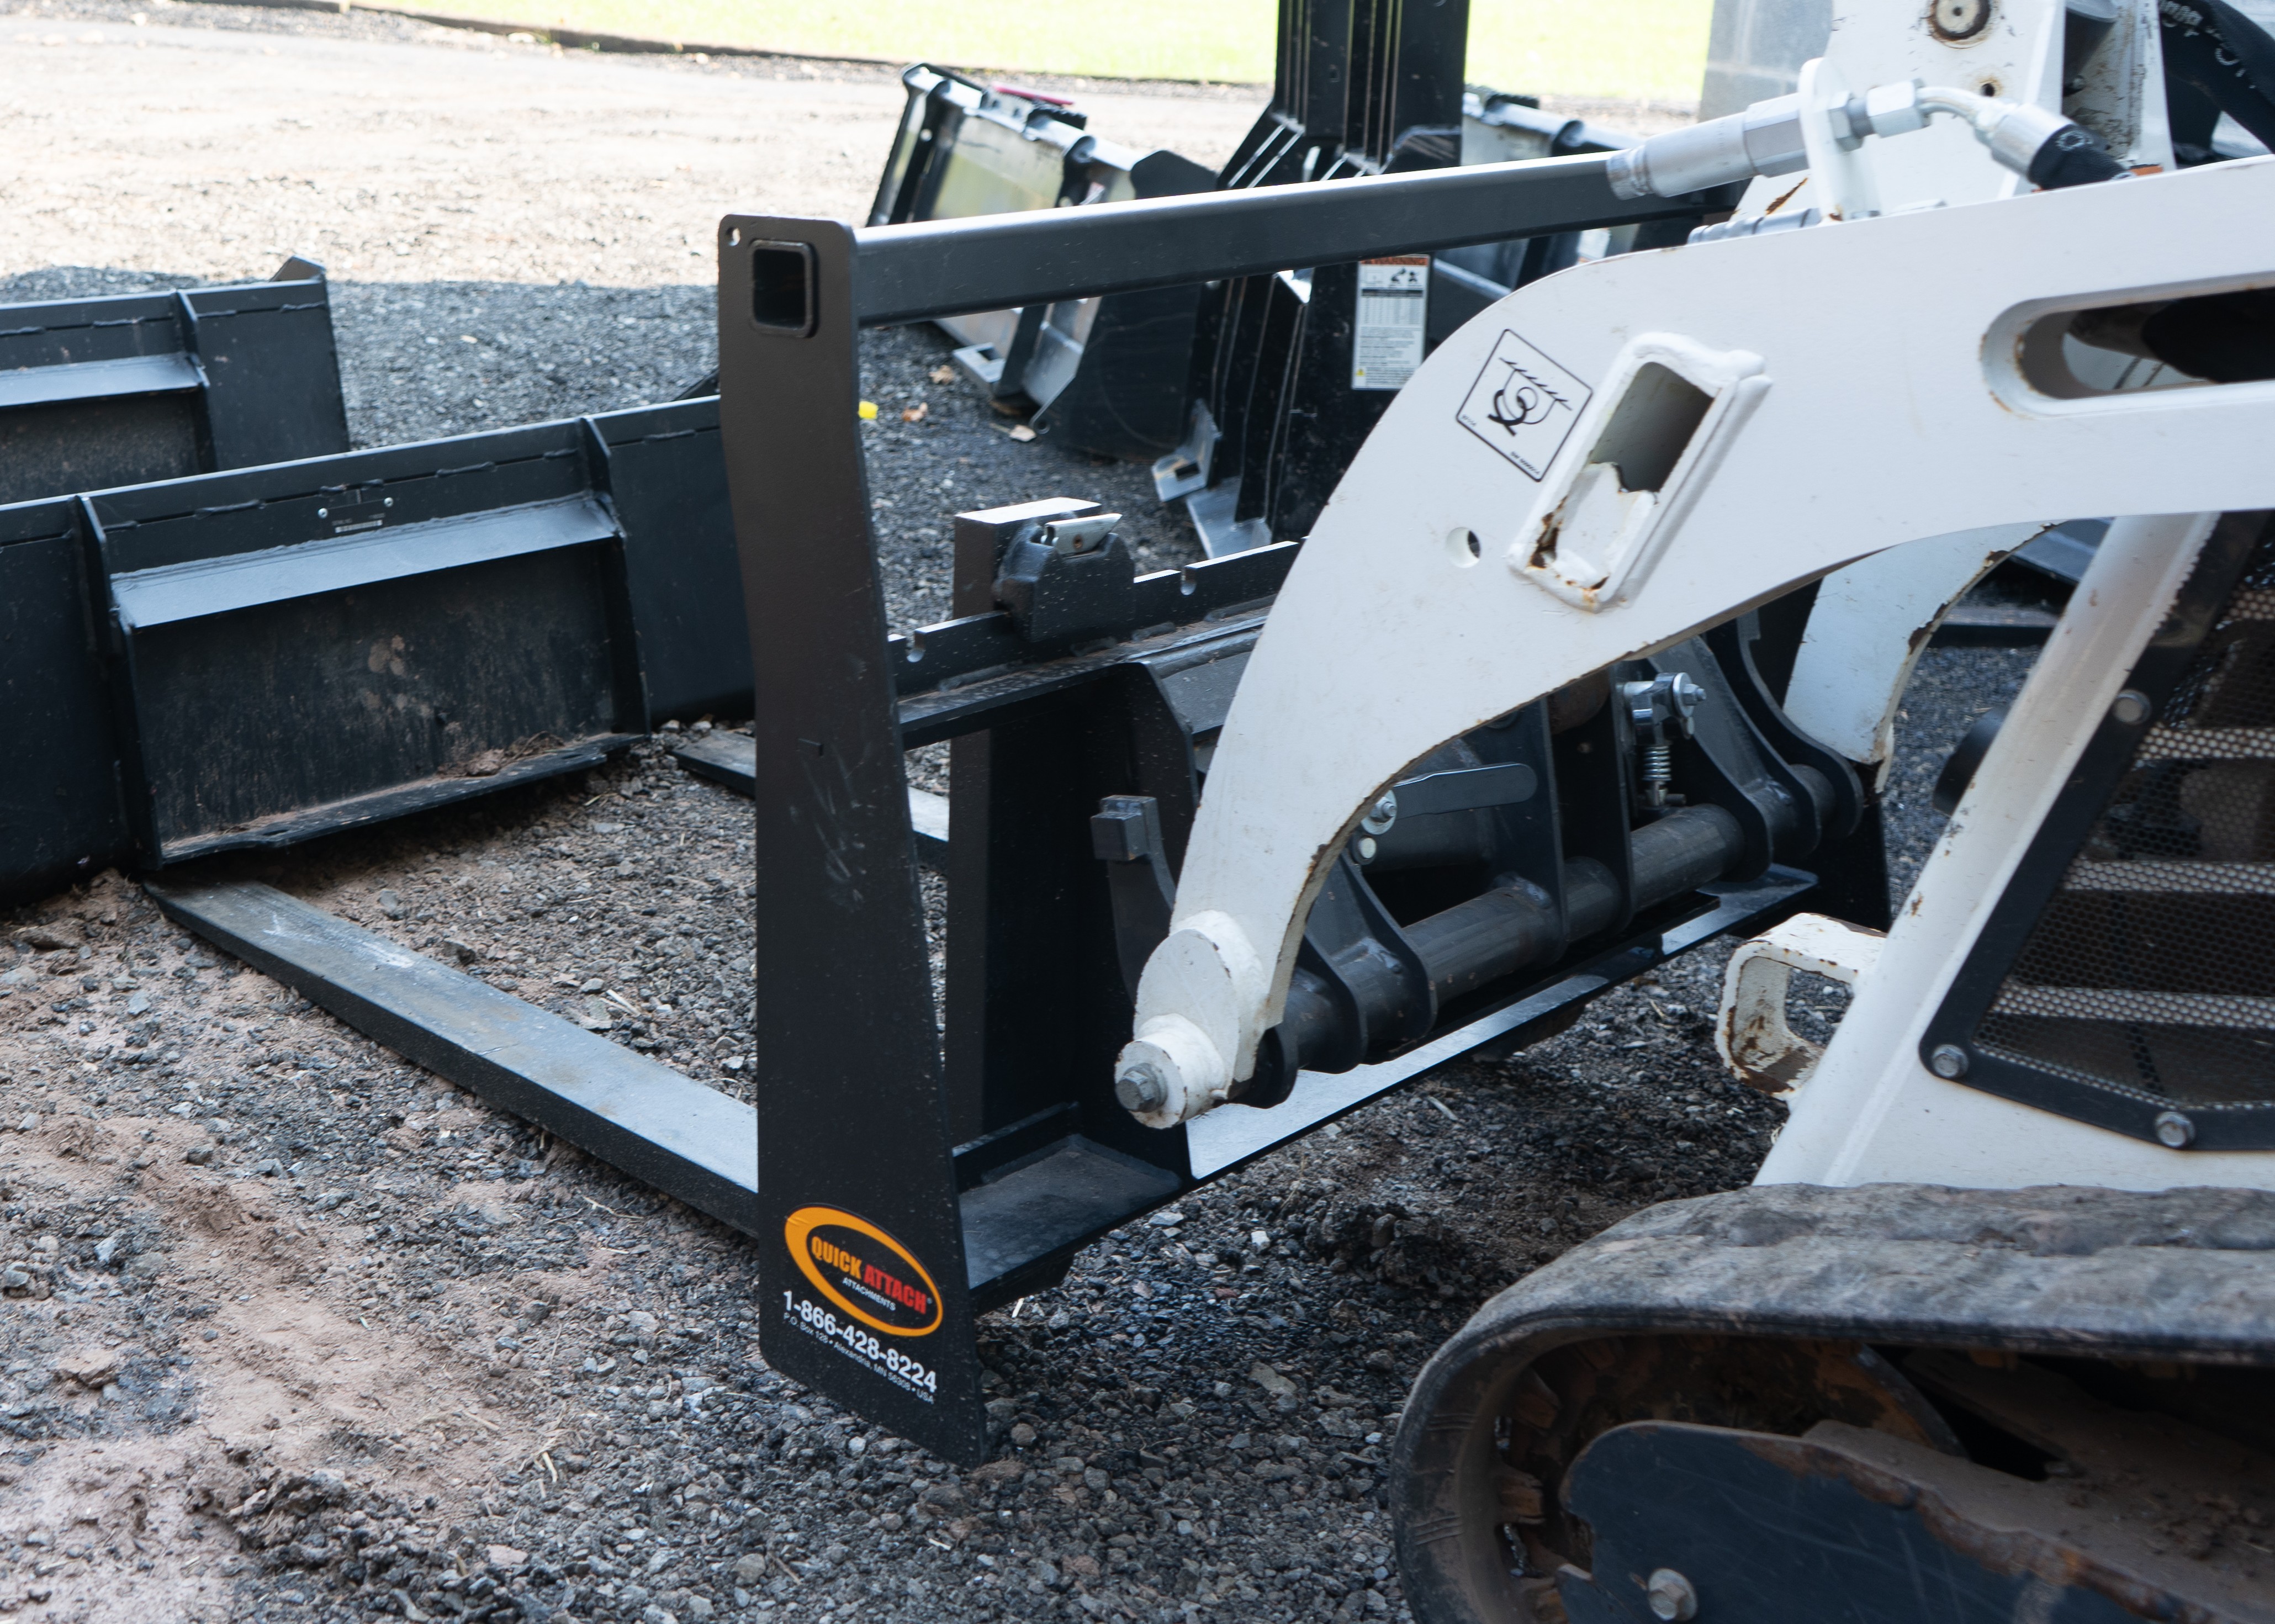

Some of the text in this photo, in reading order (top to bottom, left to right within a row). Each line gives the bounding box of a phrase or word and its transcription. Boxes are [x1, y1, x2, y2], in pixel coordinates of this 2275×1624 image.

[811, 1236, 862, 1279] QUICK
[842, 1277, 896, 1311] ATTACHMENTS
[783, 1290, 937, 1393] 1-866-428-8224
[873, 1363, 887, 1377] MN
[916, 1388, 934, 1405] USA
